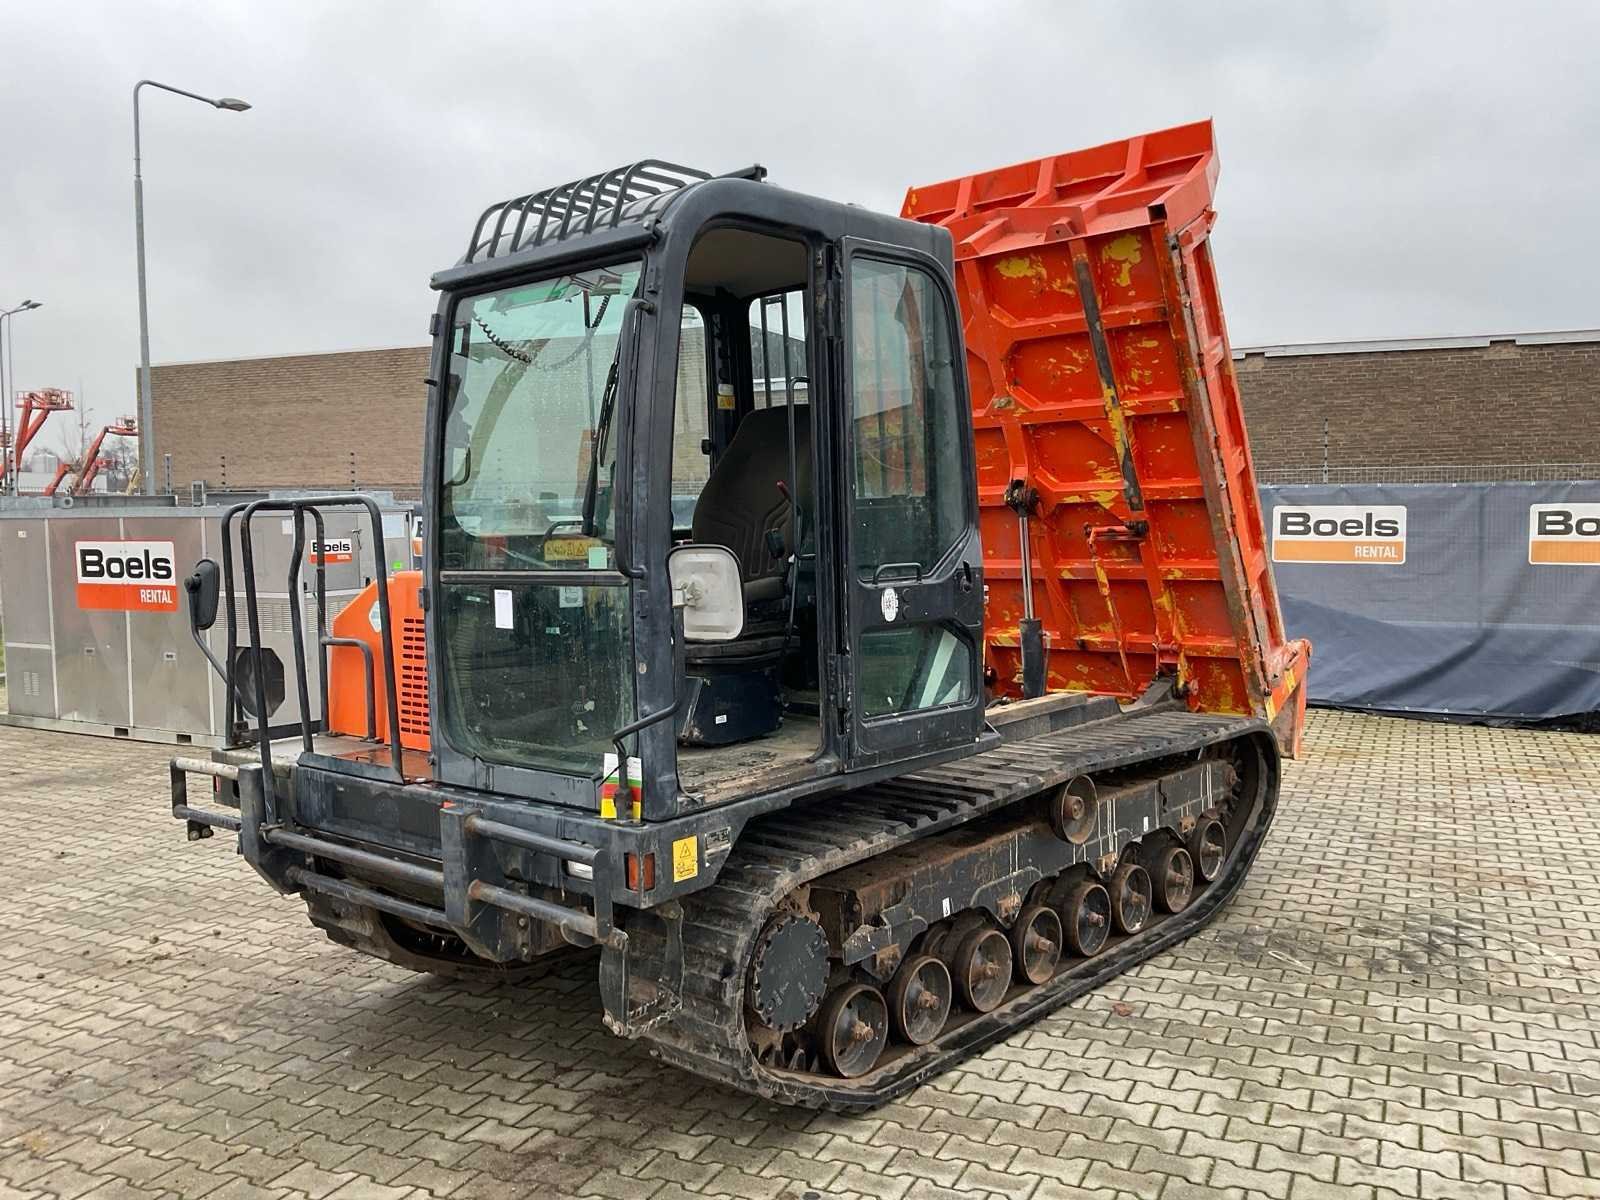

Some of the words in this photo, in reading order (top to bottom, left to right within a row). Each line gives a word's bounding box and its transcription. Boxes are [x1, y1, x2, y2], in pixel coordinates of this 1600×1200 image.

[1279, 512, 1399, 537] Boels
[1354, 545, 1398, 559] RENTAL
[79, 548, 172, 580] Boels
[140, 589, 173, 604] RENTAL
